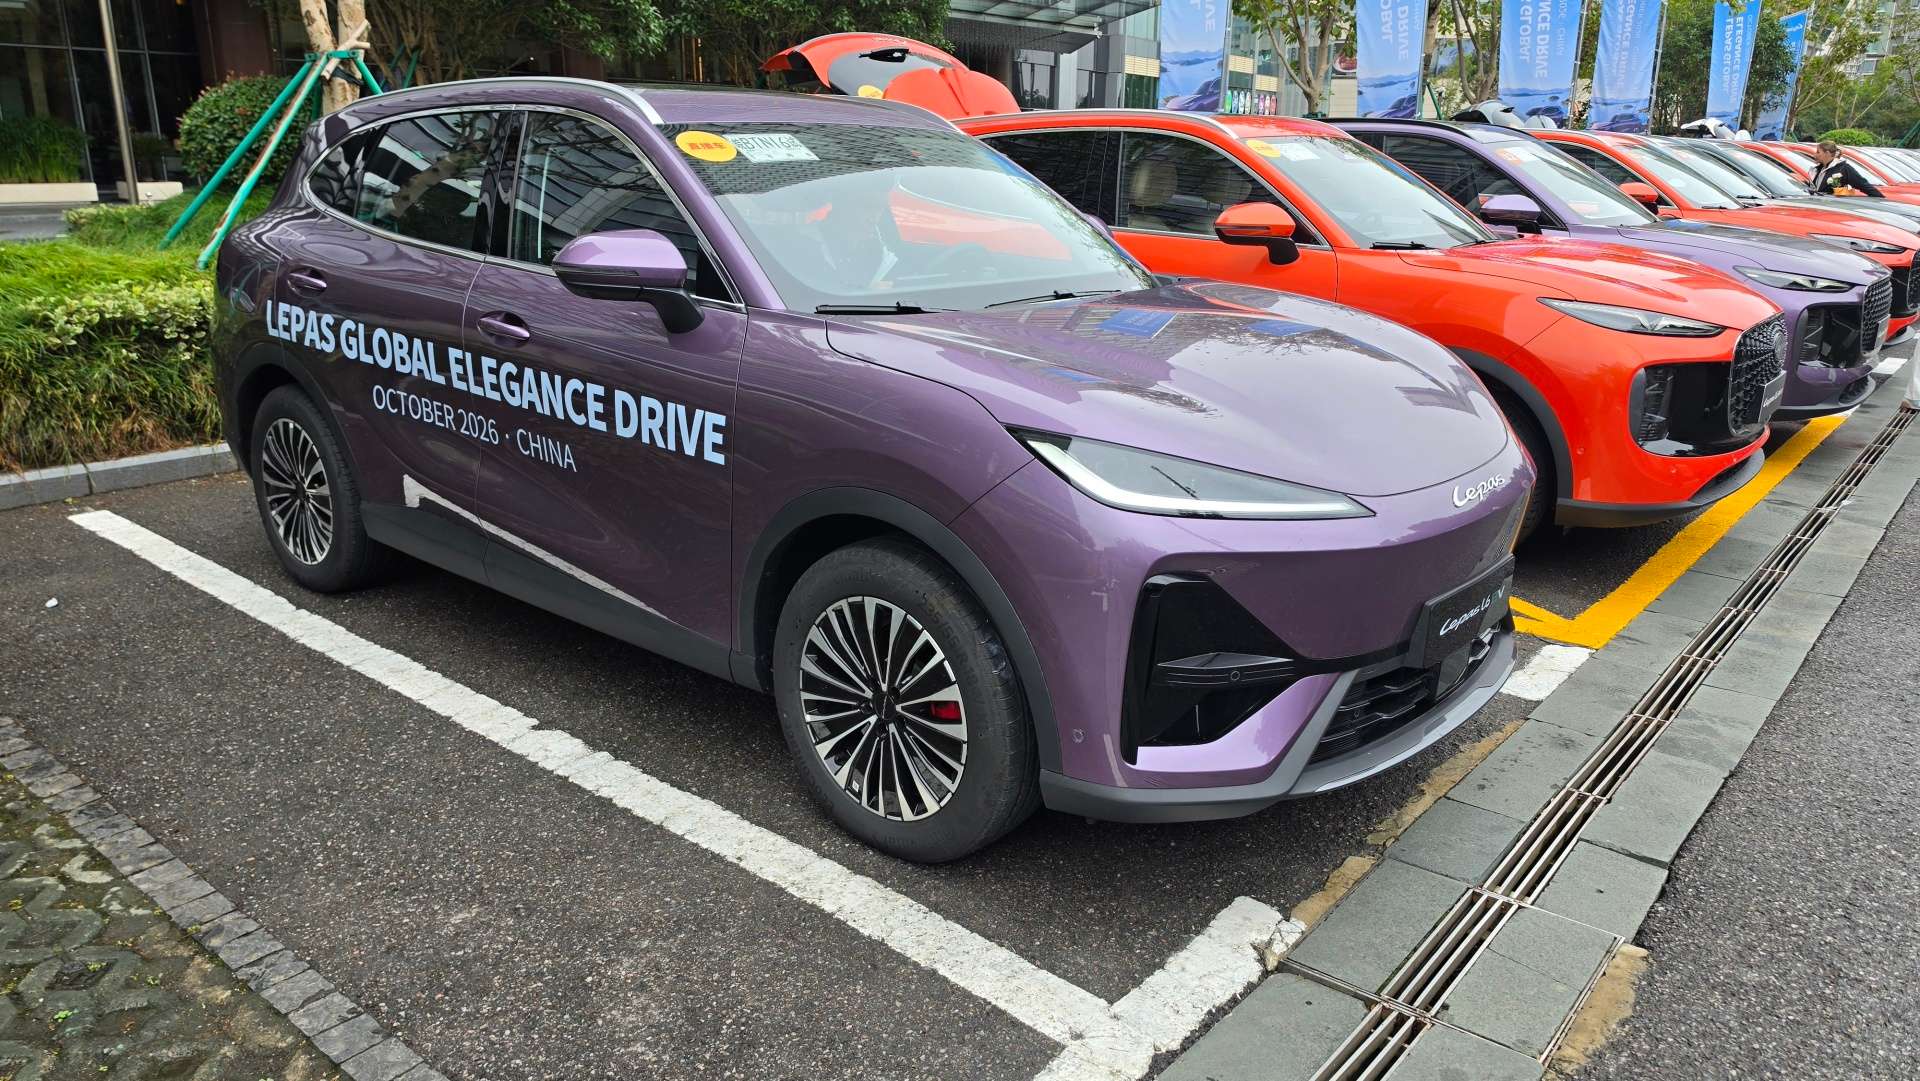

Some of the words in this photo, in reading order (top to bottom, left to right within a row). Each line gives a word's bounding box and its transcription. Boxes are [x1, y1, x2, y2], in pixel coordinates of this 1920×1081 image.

[266, 300, 335, 353] LEPAS
[340, 320, 446, 385] GLOBAL
[448, 346, 607, 432] ELEGANCE
[615, 389, 727, 466] DRIVE
[373, 384, 456, 431] OCTOBER
[457, 408, 499, 445] 2026
[517, 428, 577, 473] CHINA
[1453, 473, 1505, 507] Lepas
[1440, 605, 1480, 636] Lepas
